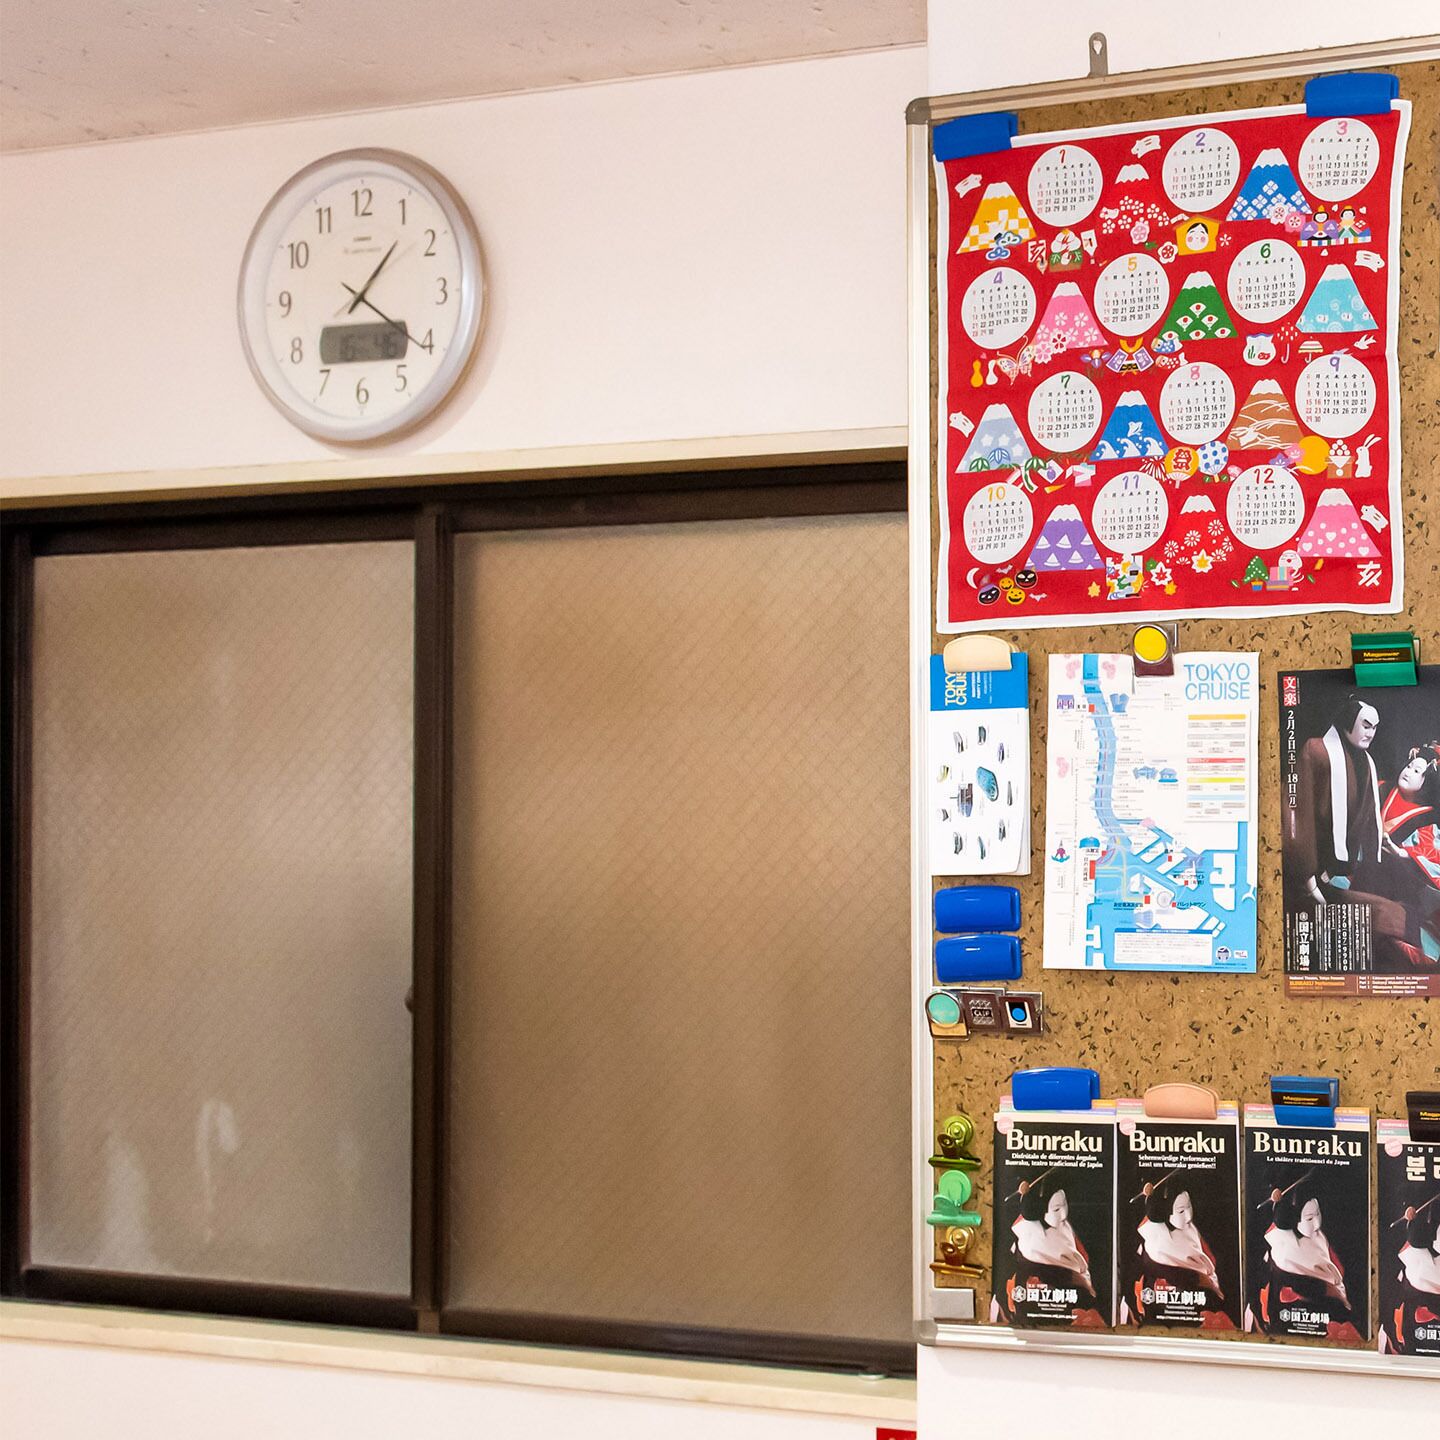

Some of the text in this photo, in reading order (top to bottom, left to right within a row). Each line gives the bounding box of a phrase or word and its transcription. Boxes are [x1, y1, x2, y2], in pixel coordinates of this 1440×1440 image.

[1195, 132, 1206, 146] 2
[1336, 121, 1348, 135] 3
[1059, 149, 1066, 163] 1
[351, 188, 373, 216] 12
[398, 198, 406, 225] 1
[315, 206, 332, 234] 11
[424, 229, 436, 257] 2
[1260, 243, 1271, 258] 6
[287, 241, 309, 269] 10
[1127, 256, 1138, 272] 5
[993, 271, 1003, 284] 4
[435, 277, 448, 305] 3
[279, 291, 292, 317] 9
[290, 336, 303, 364] 8
[422, 328, 434, 355] 4
[1191, 366, 1200, 380] 8
[1330, 356, 1340, 372] 9
[320, 369, 331, 396] 7
[395, 365, 407, 392] 5
[1061, 375, 1071, 389] 7
[356, 377, 369, 404] 6
[1173, 449, 1192, 470] 祭
[1122, 474, 1139, 490] 11
[1254, 468, 1274, 484] 12
[988, 486, 1006, 502] 10
[1356, 560, 1383, 587] 亥
[1184, 663, 1250, 681] TOKYO
[1185, 682, 1250, 700] CRUISE
[1283, 676, 1296, 706] 文楽
[1299, 921, 1310, 967] 国立劇場
[1007, 1129, 1102, 1152] Bunraku
[1130, 1130, 1224, 1153] Bunraku
[1253, 1131, 1362, 1156] Bunraku
[1027, 1288, 1078, 1304] 国立劇場
[1156, 1290, 1206, 1306] 国立劇場
[1291, 1311, 1330, 1324] 国立劇場
